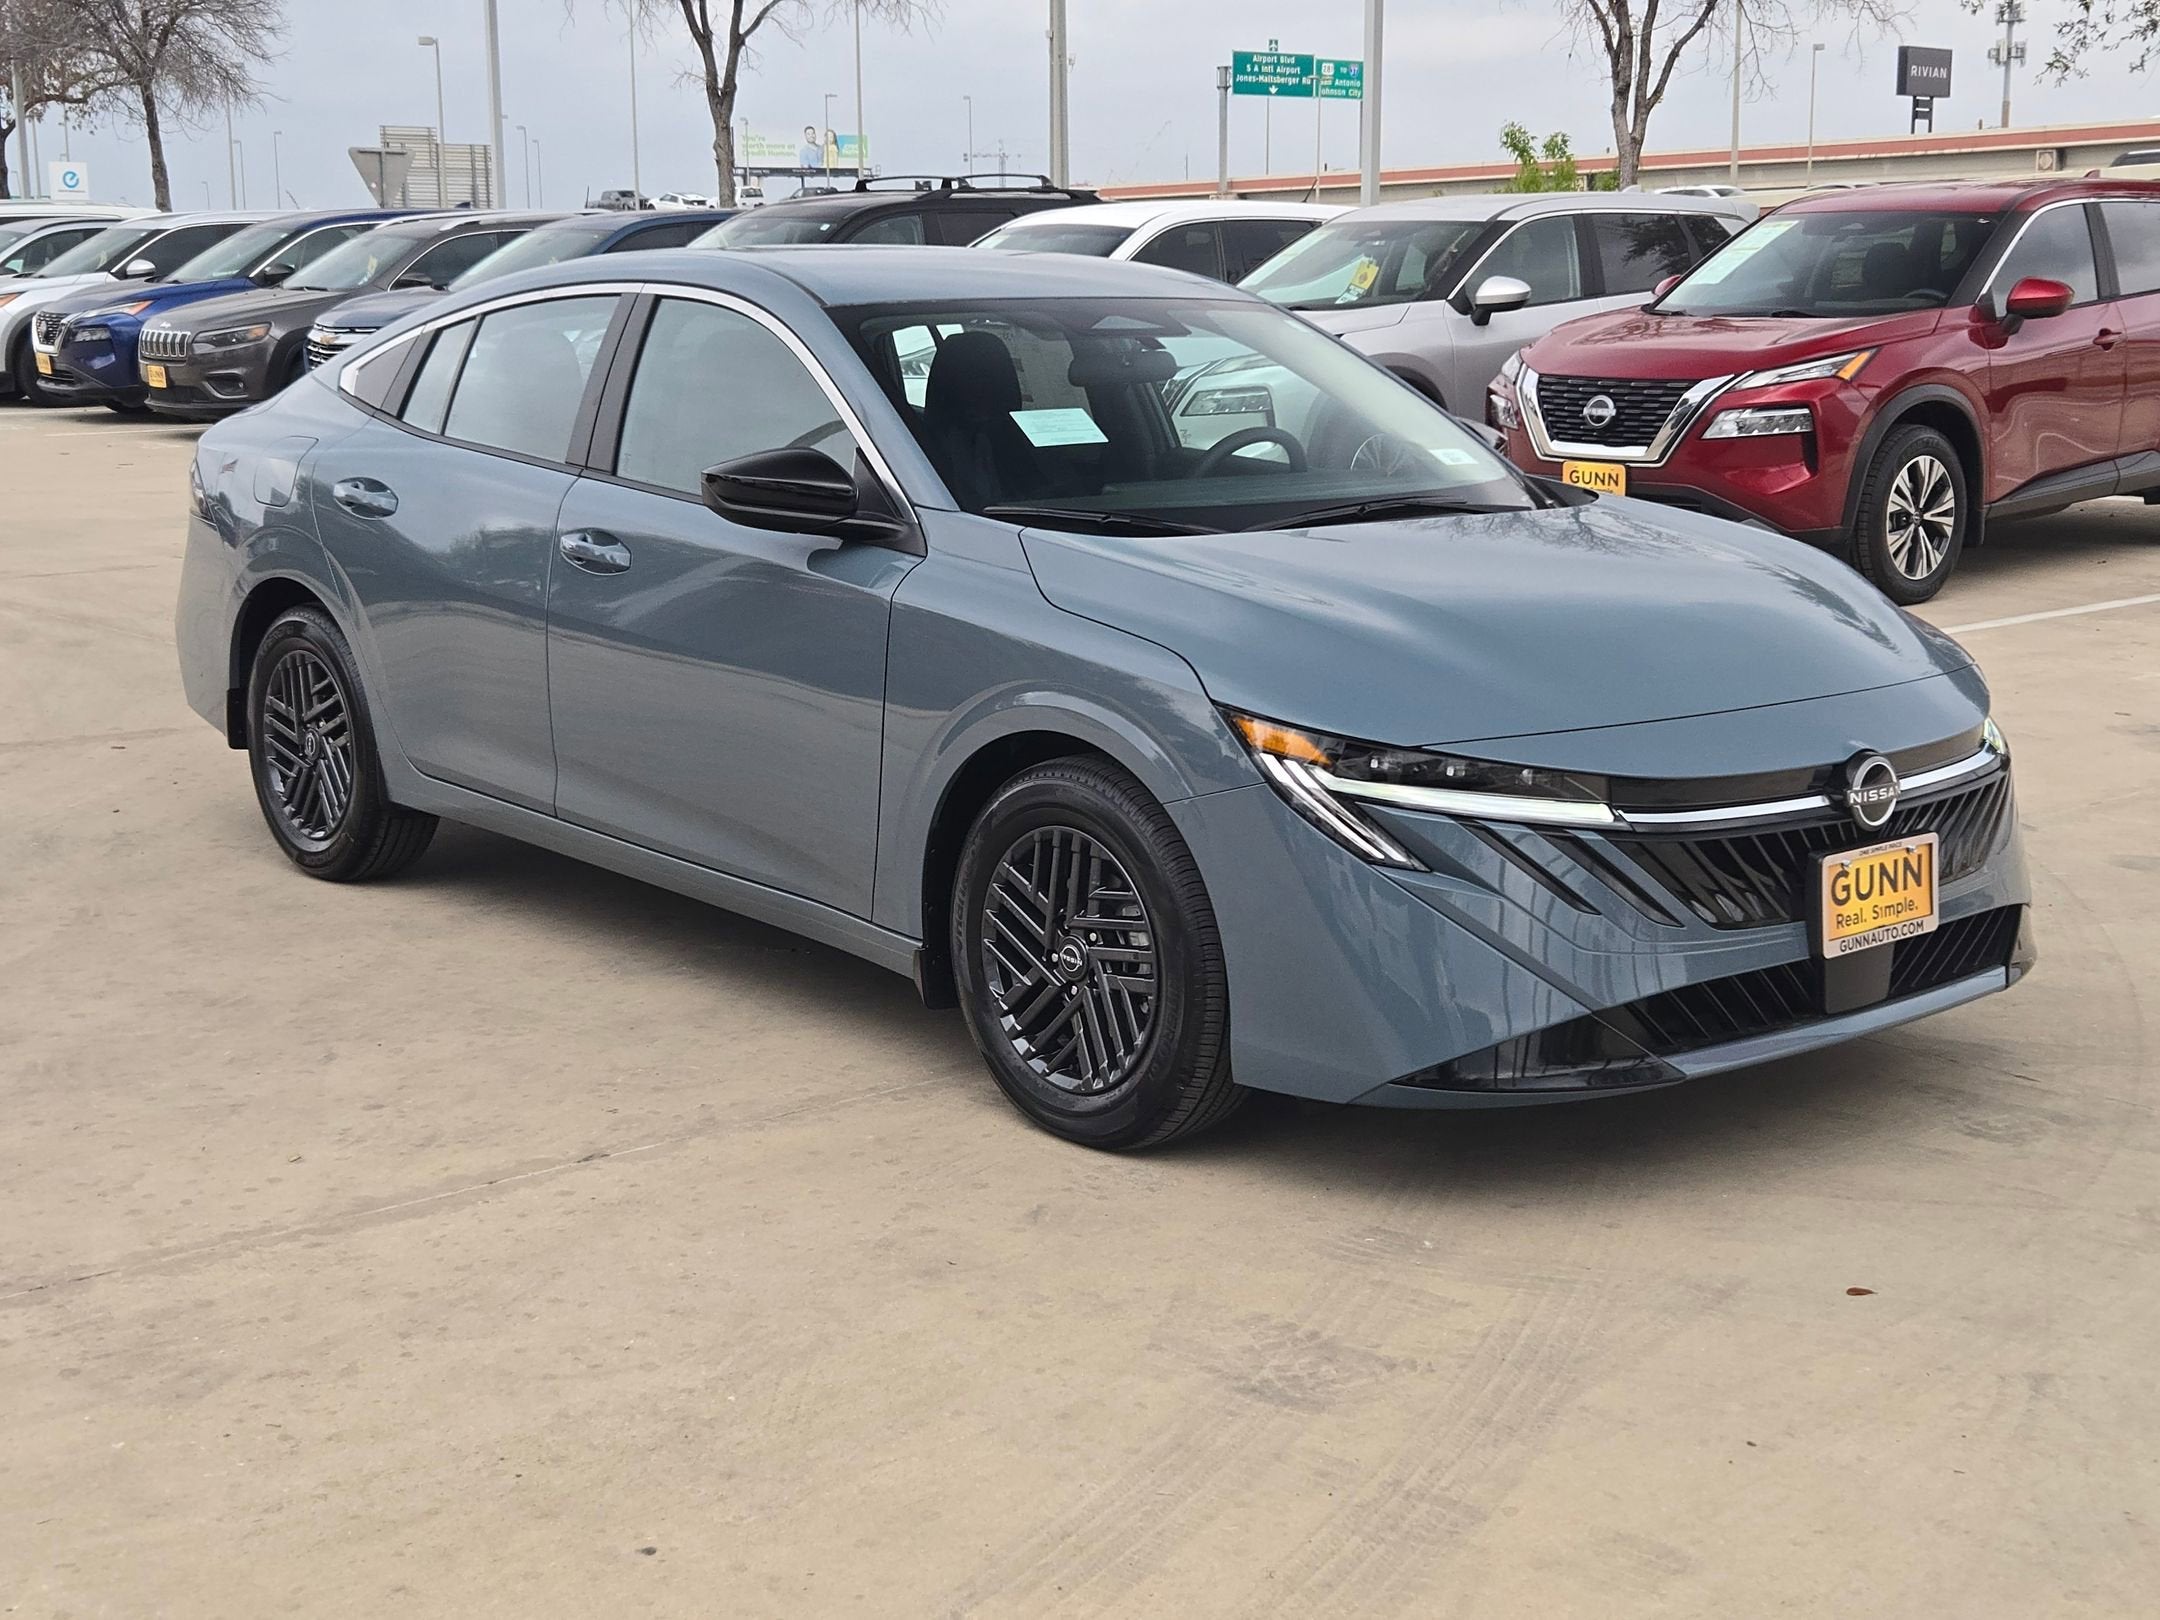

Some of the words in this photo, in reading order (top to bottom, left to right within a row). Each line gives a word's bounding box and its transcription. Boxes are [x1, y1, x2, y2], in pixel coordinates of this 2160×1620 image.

[1252, 54, 1277, 64] Airport
[1280, 55, 1296, 64] Blvd
[1246, 64, 1251, 72] S
[1253, 64, 1259, 72] A
[1276, 66, 1301, 75] Airport
[1910, 65, 1948, 79] RIVIAN
[1334, 79, 1361, 87] Antonio
[1320, 88, 1346, 96] ohnson
[1348, 89, 1361, 98] City
[1569, 469, 1619, 487] GUNN
[1850, 785, 1901, 804] NISSAN
[1830, 853, 1922, 907] GUNN
[1836, 907, 1867, 929] Real.
[1872, 897, 1918, 919] Simple.
[1840, 920, 1924, 952] GUNNAUTO.COM
